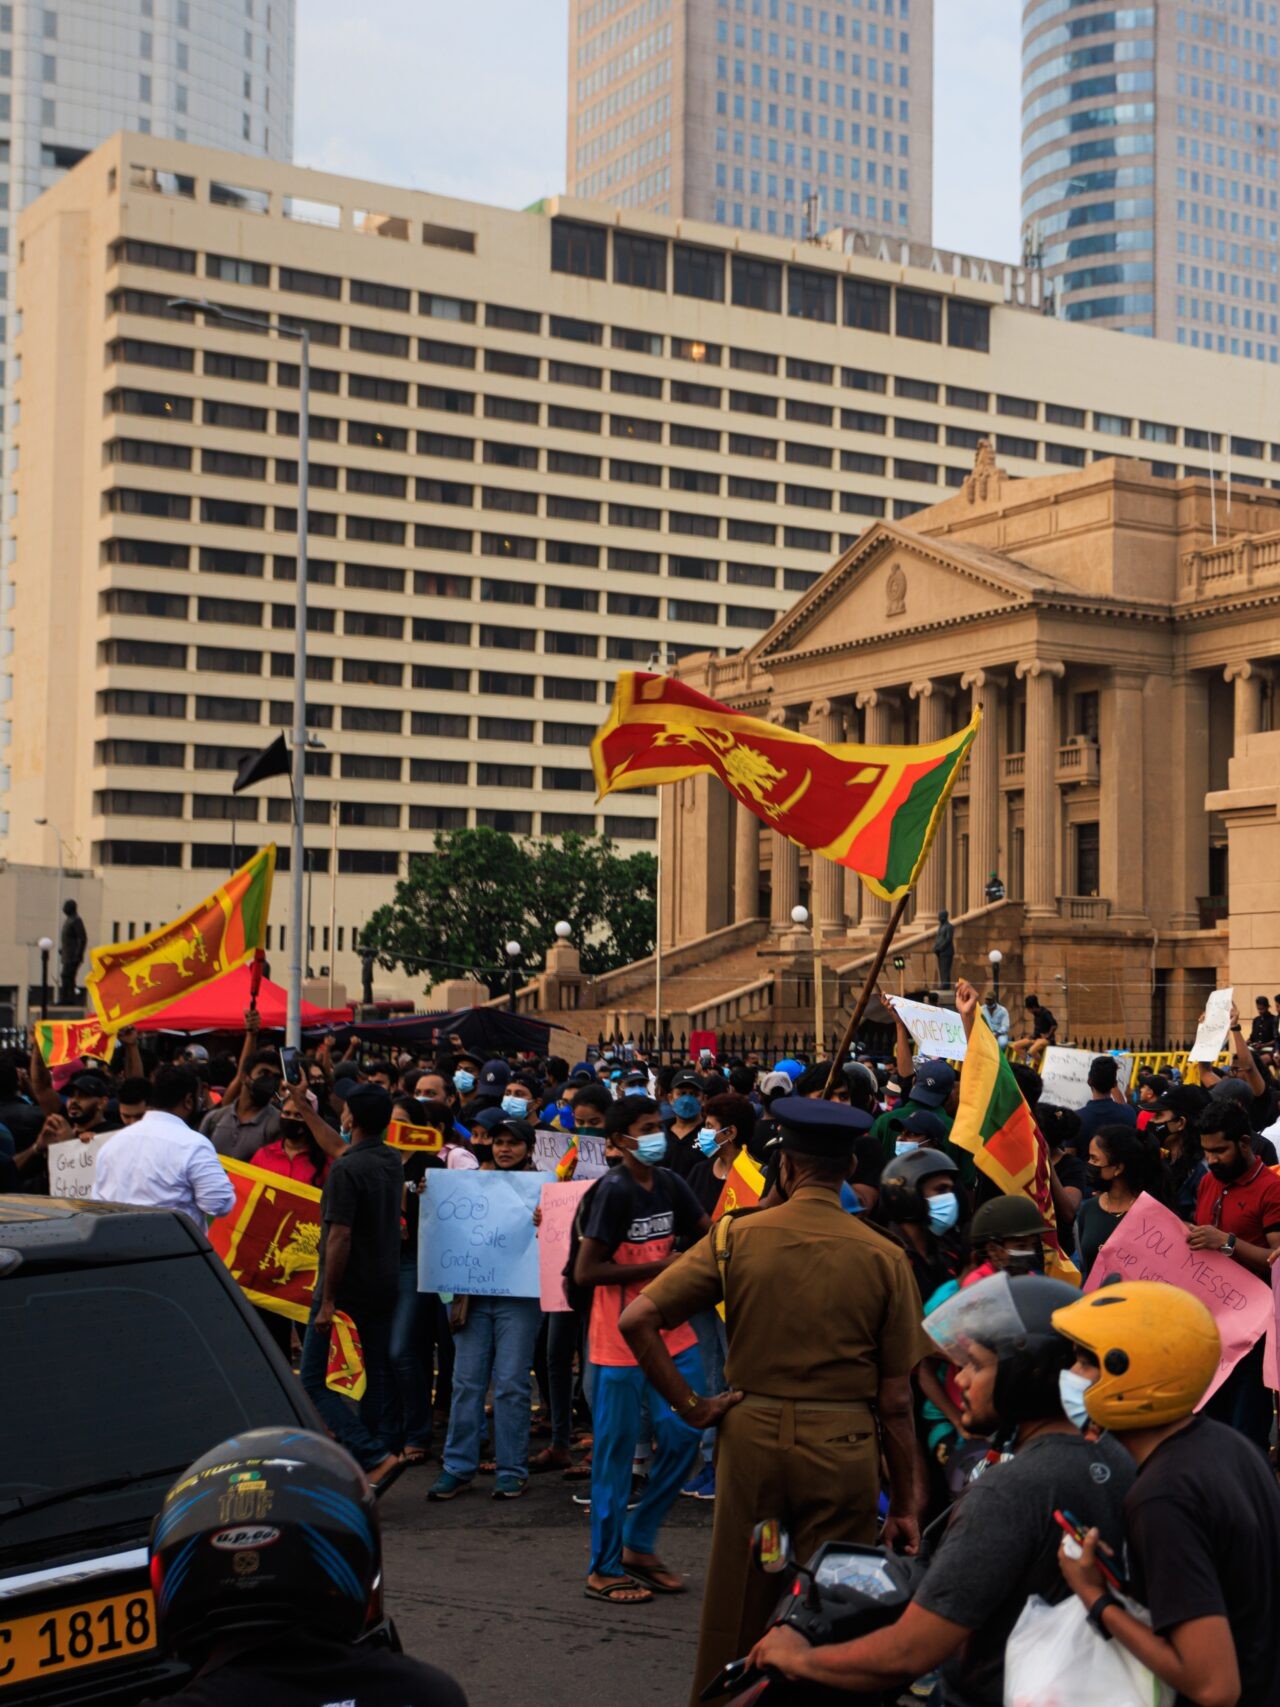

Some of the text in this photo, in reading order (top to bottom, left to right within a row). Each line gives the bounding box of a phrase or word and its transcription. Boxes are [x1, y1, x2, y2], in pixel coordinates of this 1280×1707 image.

[1134, 1217, 1248, 1311] YOU MESSED
[38, 1598, 150, 1668] 1818
